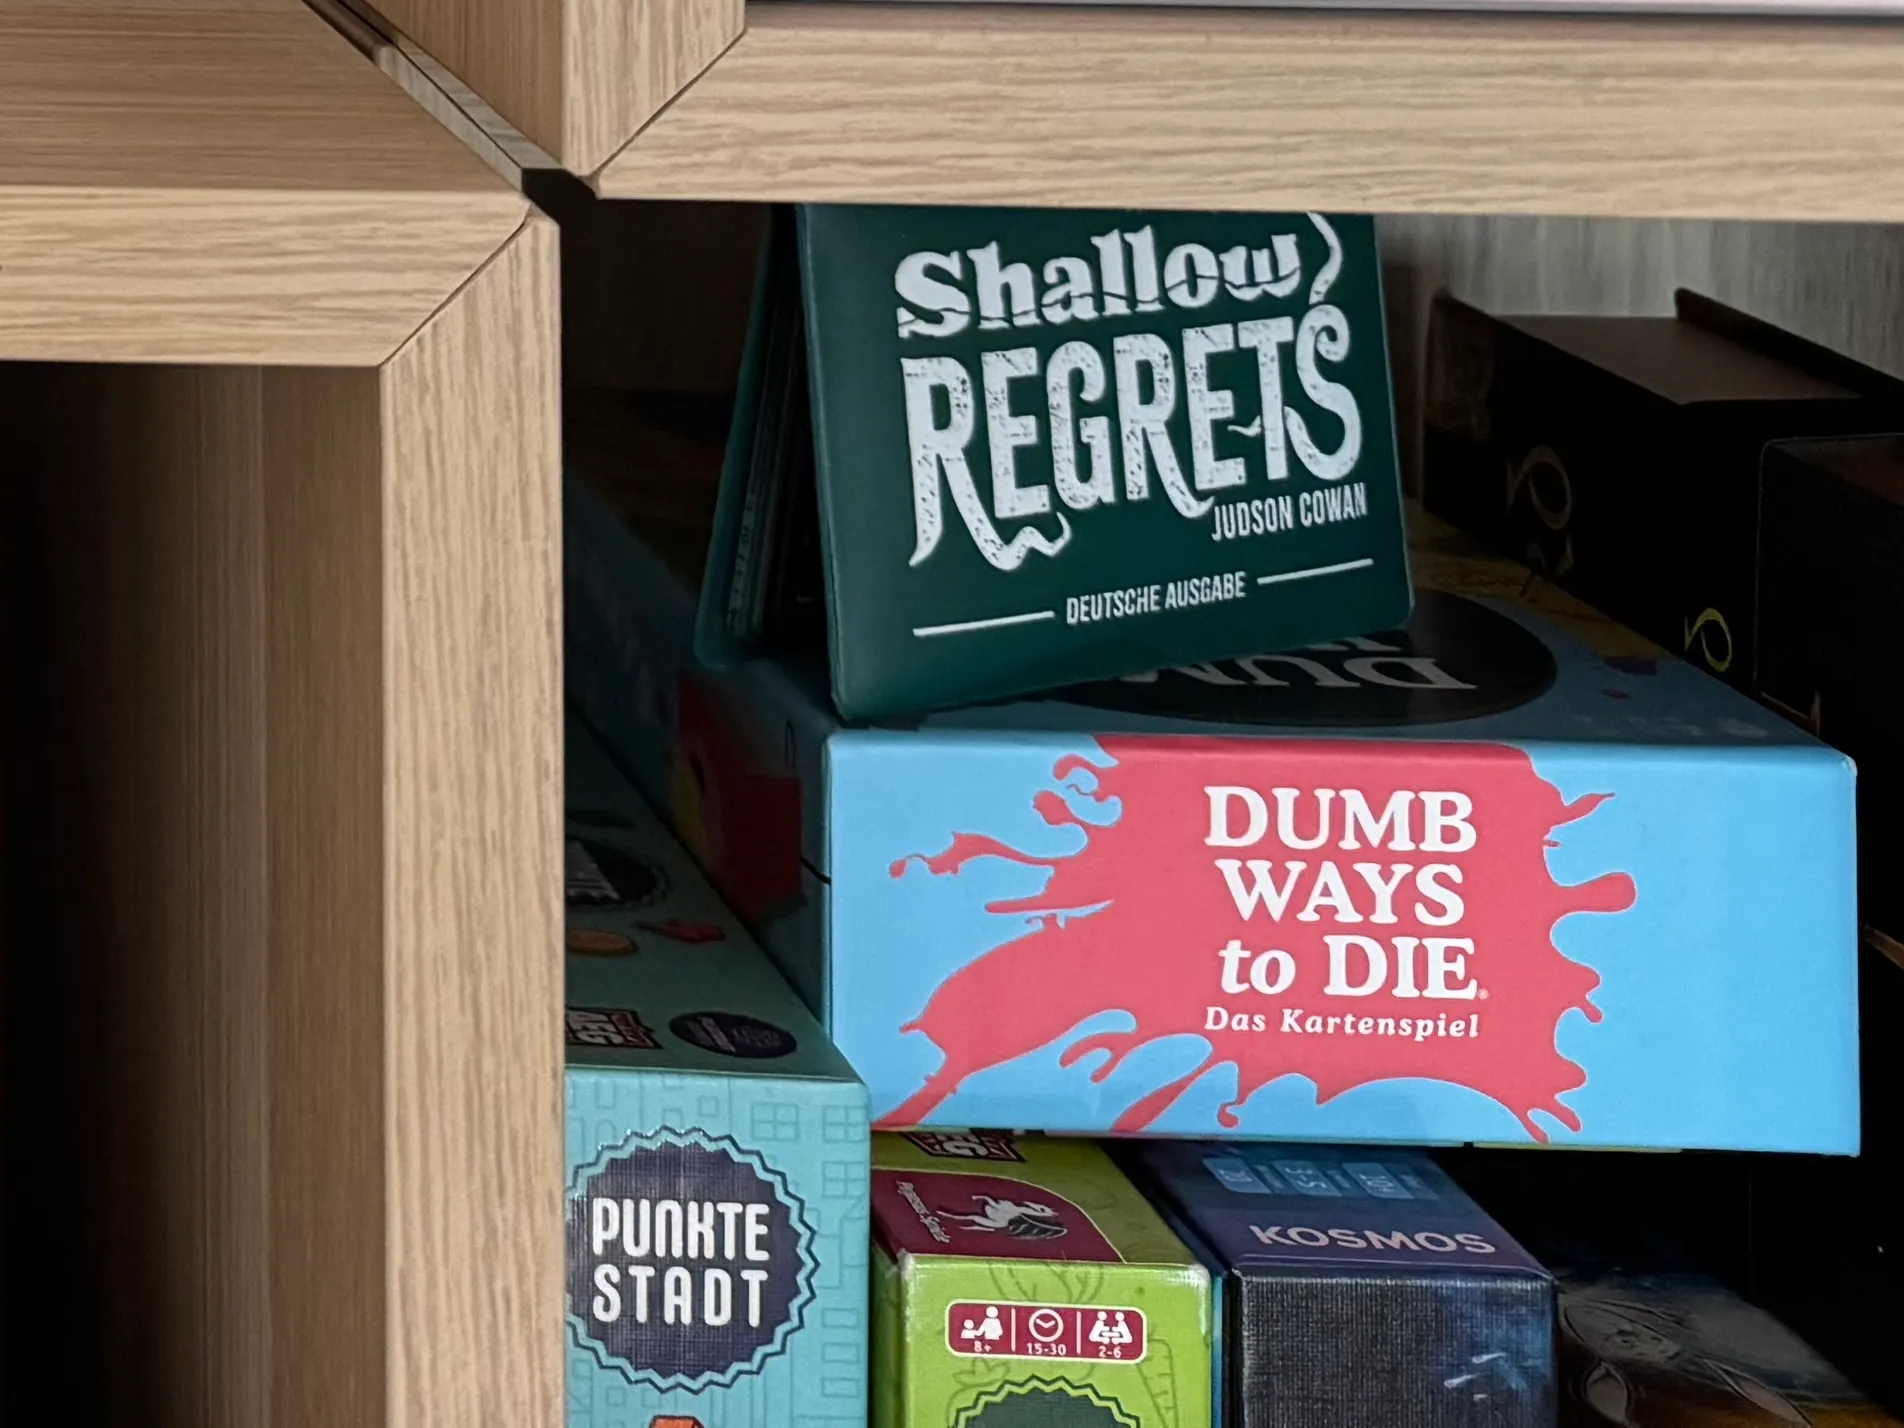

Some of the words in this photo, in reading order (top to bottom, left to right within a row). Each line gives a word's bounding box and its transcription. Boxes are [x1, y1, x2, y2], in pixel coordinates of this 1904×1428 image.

[893, 223, 1302, 340] Shallow
[897, 304, 1365, 573] REGRETS
[1211, 493, 1294, 543] JUDSON
[1299, 481, 1369, 531] COWAN
[1064, 581, 1160, 626] DEUTSCHE
[1164, 571, 1247, 615] AUSGABE
[1203, 782, 1479, 855] DUMB
[1213, 856, 1466, 927] WAYS
[1219, 940, 1295, 998] to
[1323, 936, 1479, 1001] DIE
[1204, 1004, 1269, 1036] Das
[1278, 1007, 1480, 1044] Kartenspiel
[592, 1197, 771, 1261] PUNKTE
[1249, 1222, 1498, 1256] KOSMOS
[592, 1263, 770, 1328] STADT
[972, 1340, 993, 1353] 8+
[1026, 1342, 1068, 1356] 15-30
[1098, 1345, 1123, 1359] 2-6
